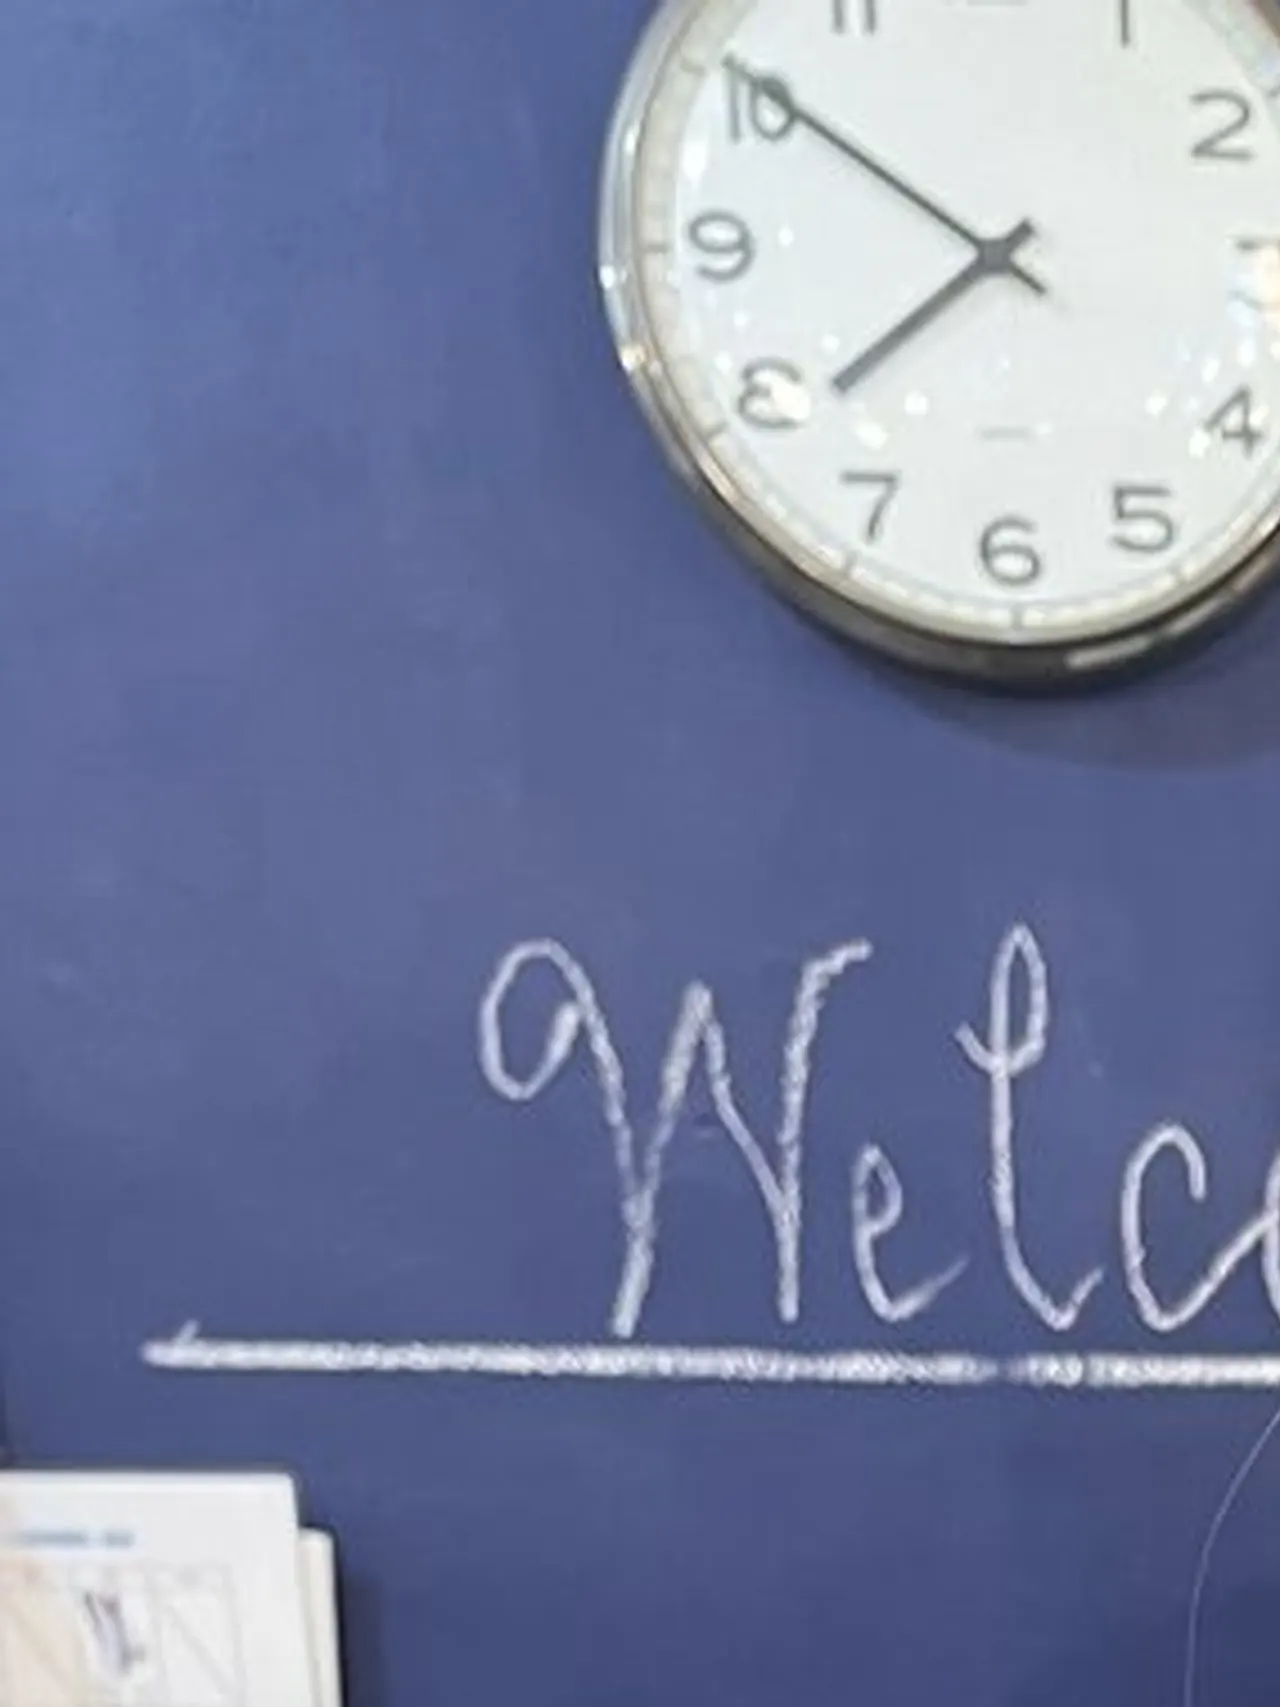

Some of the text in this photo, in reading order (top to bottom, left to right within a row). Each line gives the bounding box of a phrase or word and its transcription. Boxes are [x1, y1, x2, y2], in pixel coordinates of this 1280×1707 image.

[722, 72, 803, 143] 10
[1187, 88, 1255, 161] 2
[687, 210, 757, 282] 9
[1202, 385, 1265, 455] 4
[840, 470, 903, 544] 7
[1109, 483, 1177, 554] 5
[979, 516, 1042, 588] 6
